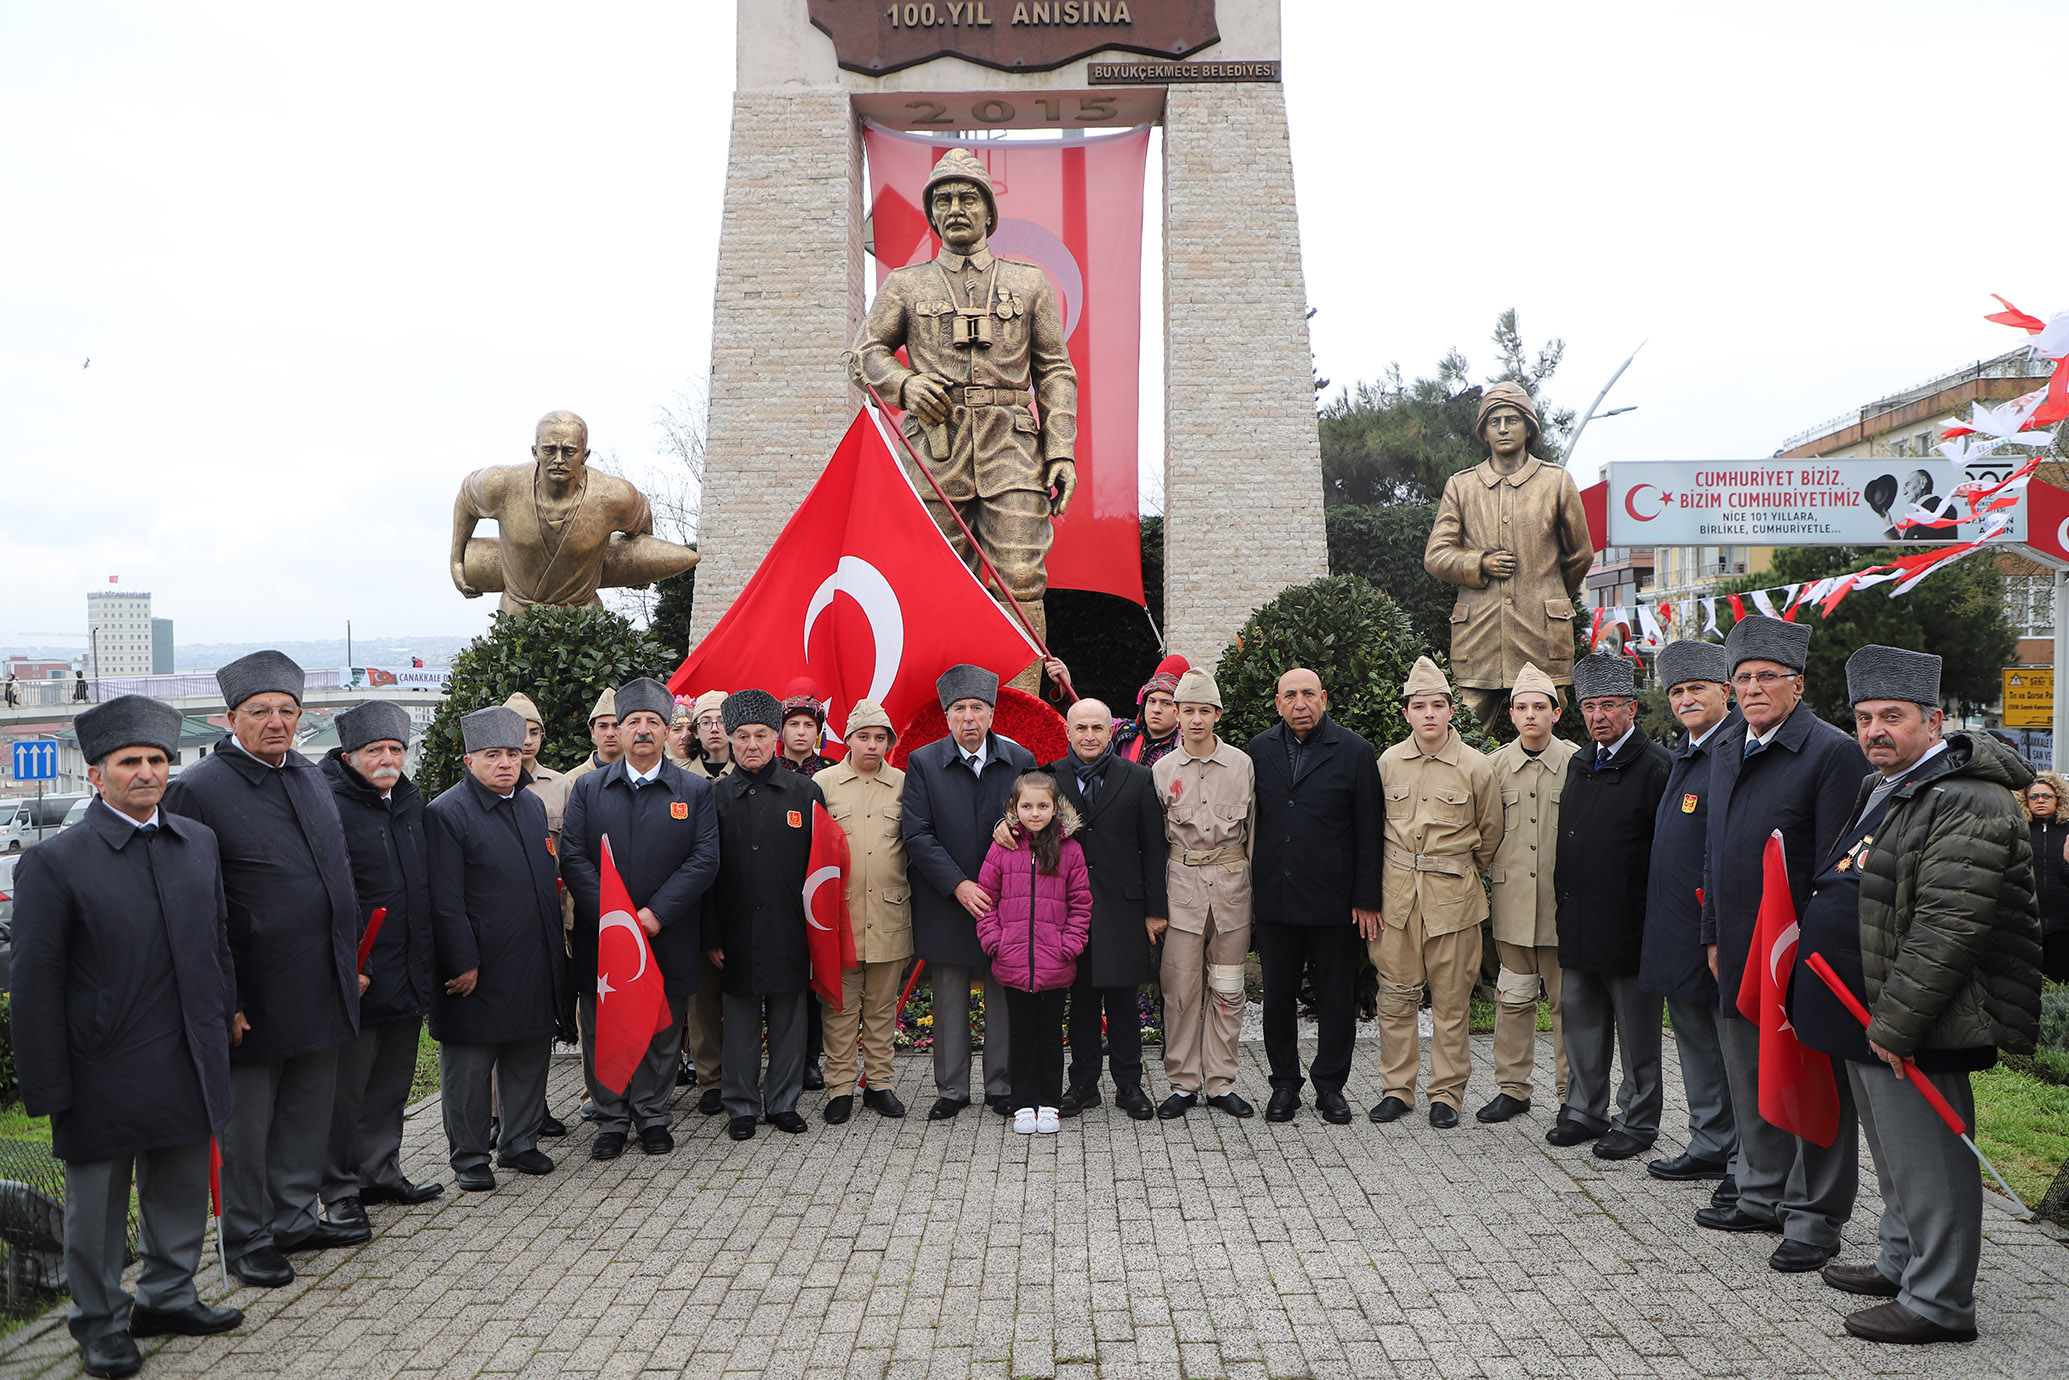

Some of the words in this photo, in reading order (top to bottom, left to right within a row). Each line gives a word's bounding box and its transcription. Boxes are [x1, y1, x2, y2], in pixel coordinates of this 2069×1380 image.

[887, 1, 992, 27] 100.YIL
[1011, 0, 1132, 25] ANISINA
[1095, 63, 1198, 80] BÜYÜKÇEKMECE
[1202, 62, 1275, 78] BELEDİYESİ
[905, 97, 1118, 124] 2015
[1695, 467, 1794, 487] CUMHURİYET
[1680, 489, 1722, 508] BİZİM
[1728, 487, 1860, 507] CUMHURİYETİMİZ
[1723, 511, 1747, 521] NİCE
[1751, 512, 1767, 521] 101
[1771, 511, 1818, 522] YILLARA,
[1700, 523, 1749, 535] BİRLİKLE,
[1753, 522, 1841, 534] CUMHURİYETLE...
[399, 673, 441, 683] ÇANAKKALE
